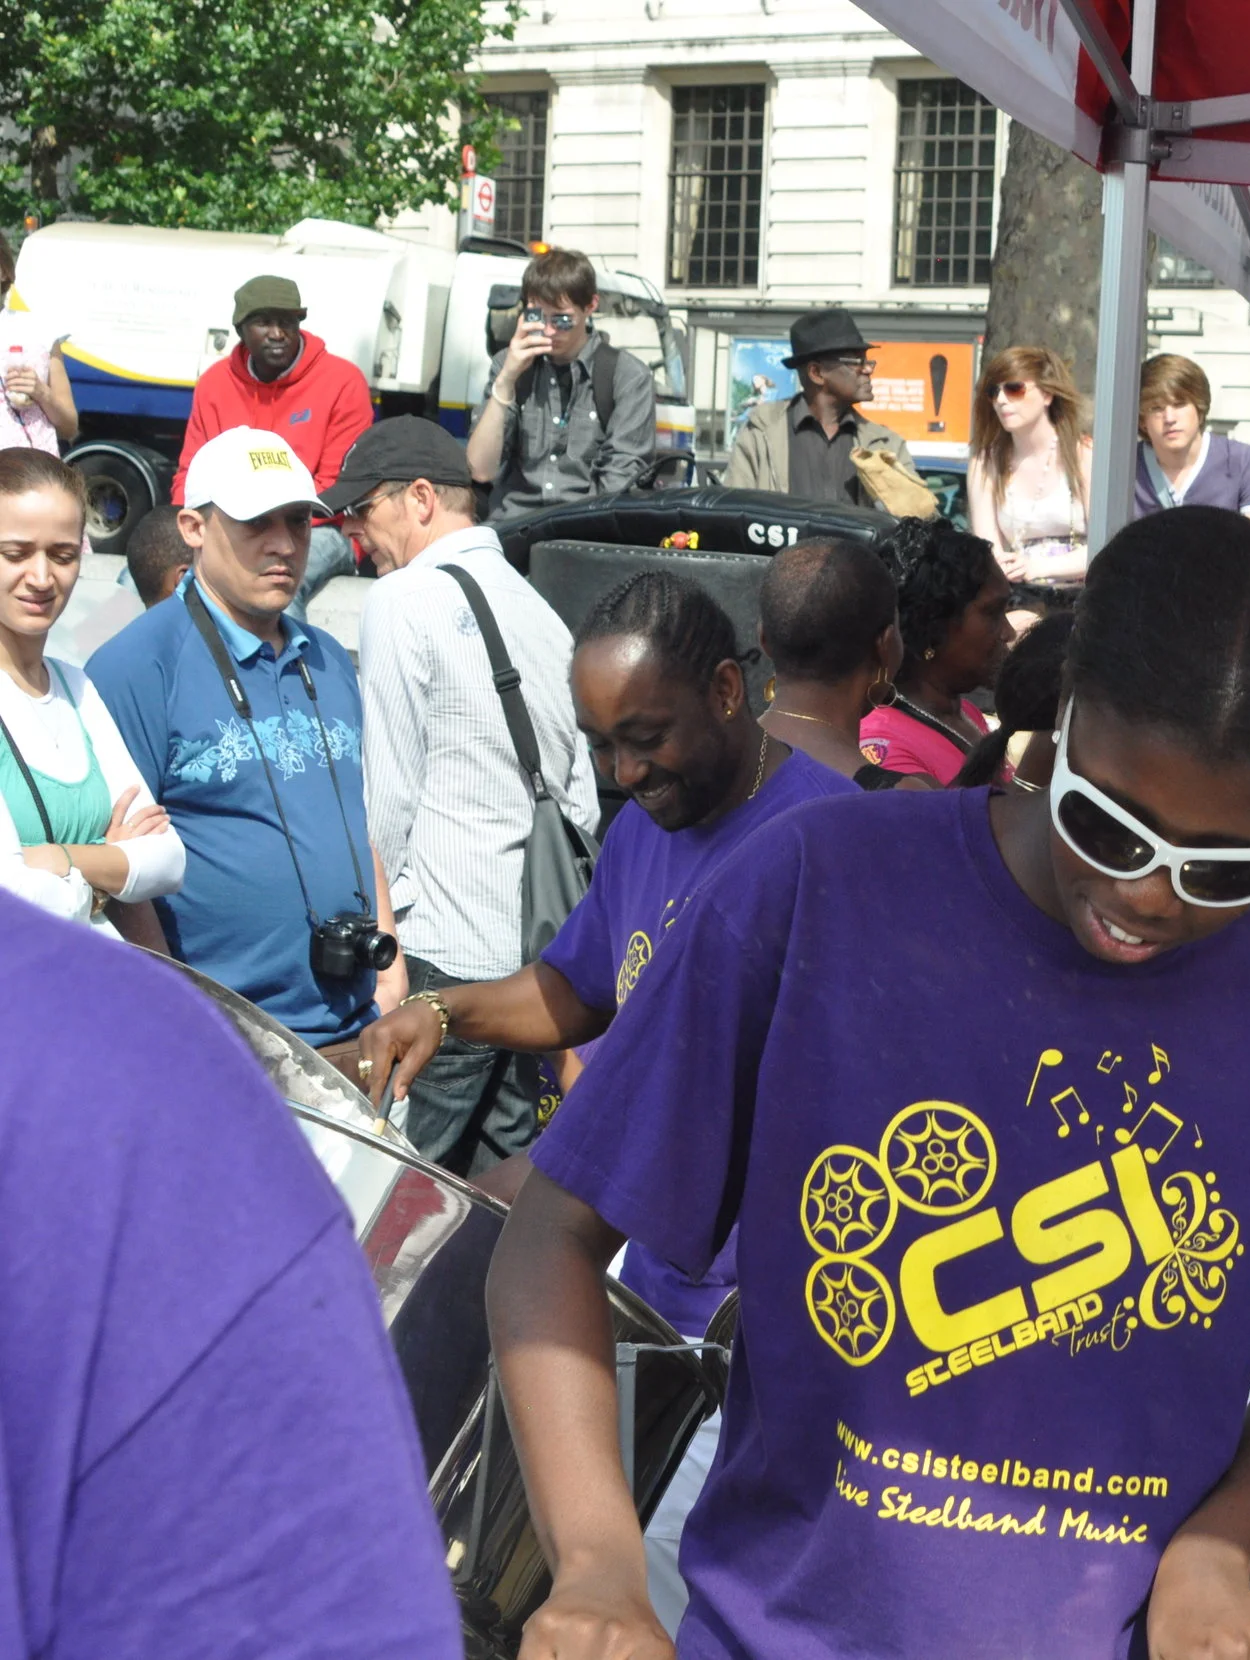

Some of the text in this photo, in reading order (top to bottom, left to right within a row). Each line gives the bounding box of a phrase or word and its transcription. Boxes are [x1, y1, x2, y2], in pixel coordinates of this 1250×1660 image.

[249, 451, 292, 470] EVERLAST
[748, 522, 799, 547] CSI
[900, 1143, 1176, 1353] CSI
[905, 1292, 1104, 1397] STEELBAND
[1051, 1302, 1132, 1357] Trust
[836, 1418, 1168, 1498] www.csisteelband.com
[877, 1486, 1046, 1536] Steelband
[1058, 1507, 1148, 1545] Music
